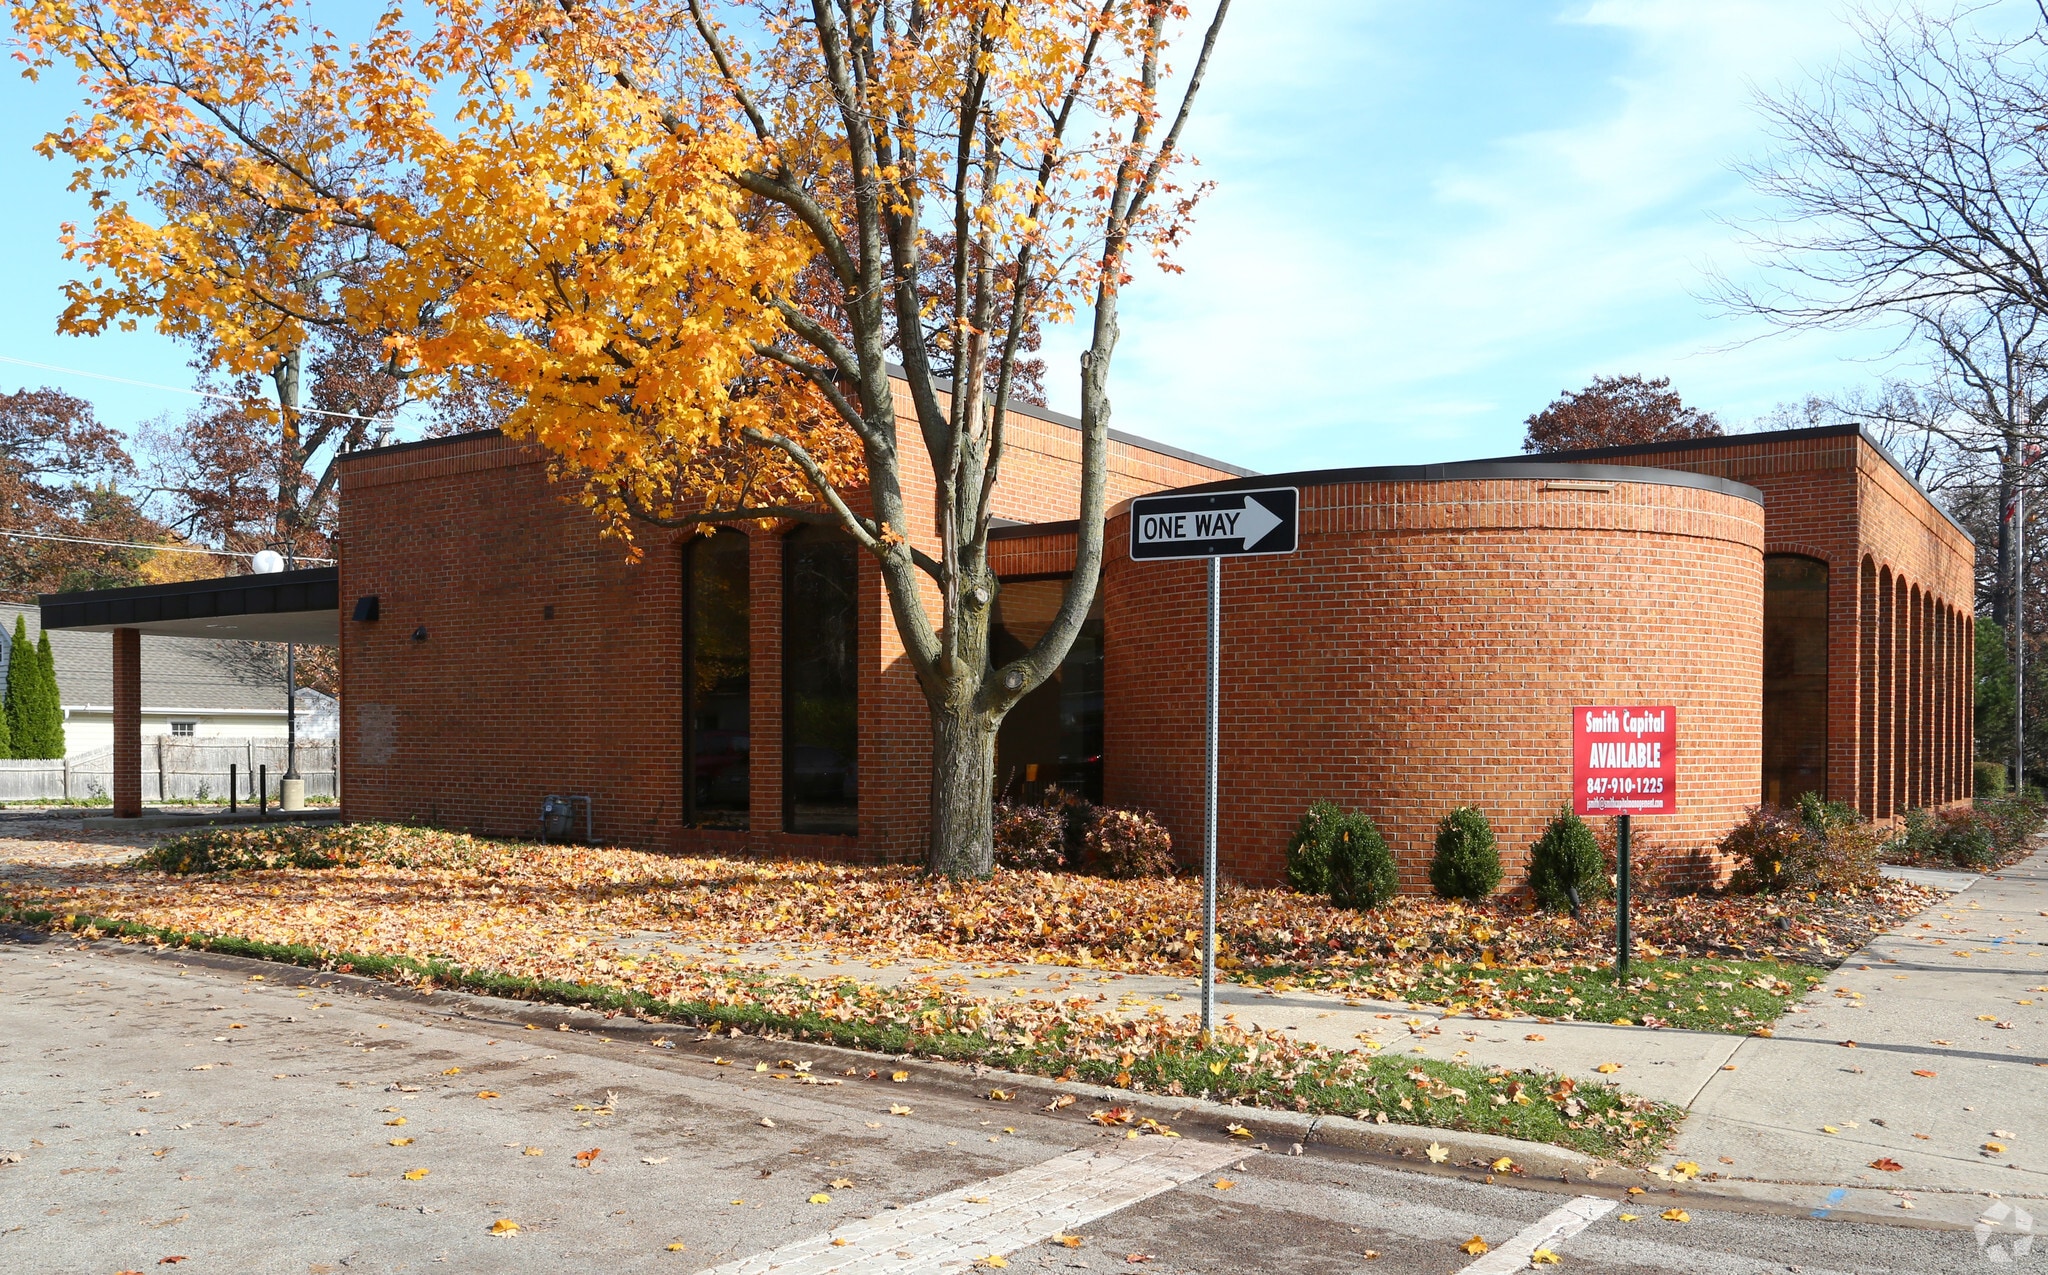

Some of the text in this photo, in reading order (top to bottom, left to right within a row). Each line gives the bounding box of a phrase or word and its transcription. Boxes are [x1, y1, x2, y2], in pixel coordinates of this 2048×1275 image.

[1144, 512, 1240, 540] ONE WAY
[1586, 710, 1665, 739] Smith Capital
[1589, 742, 1661, 768] AVAILABLE
[1587, 777, 1664, 794] 847-910-1225
